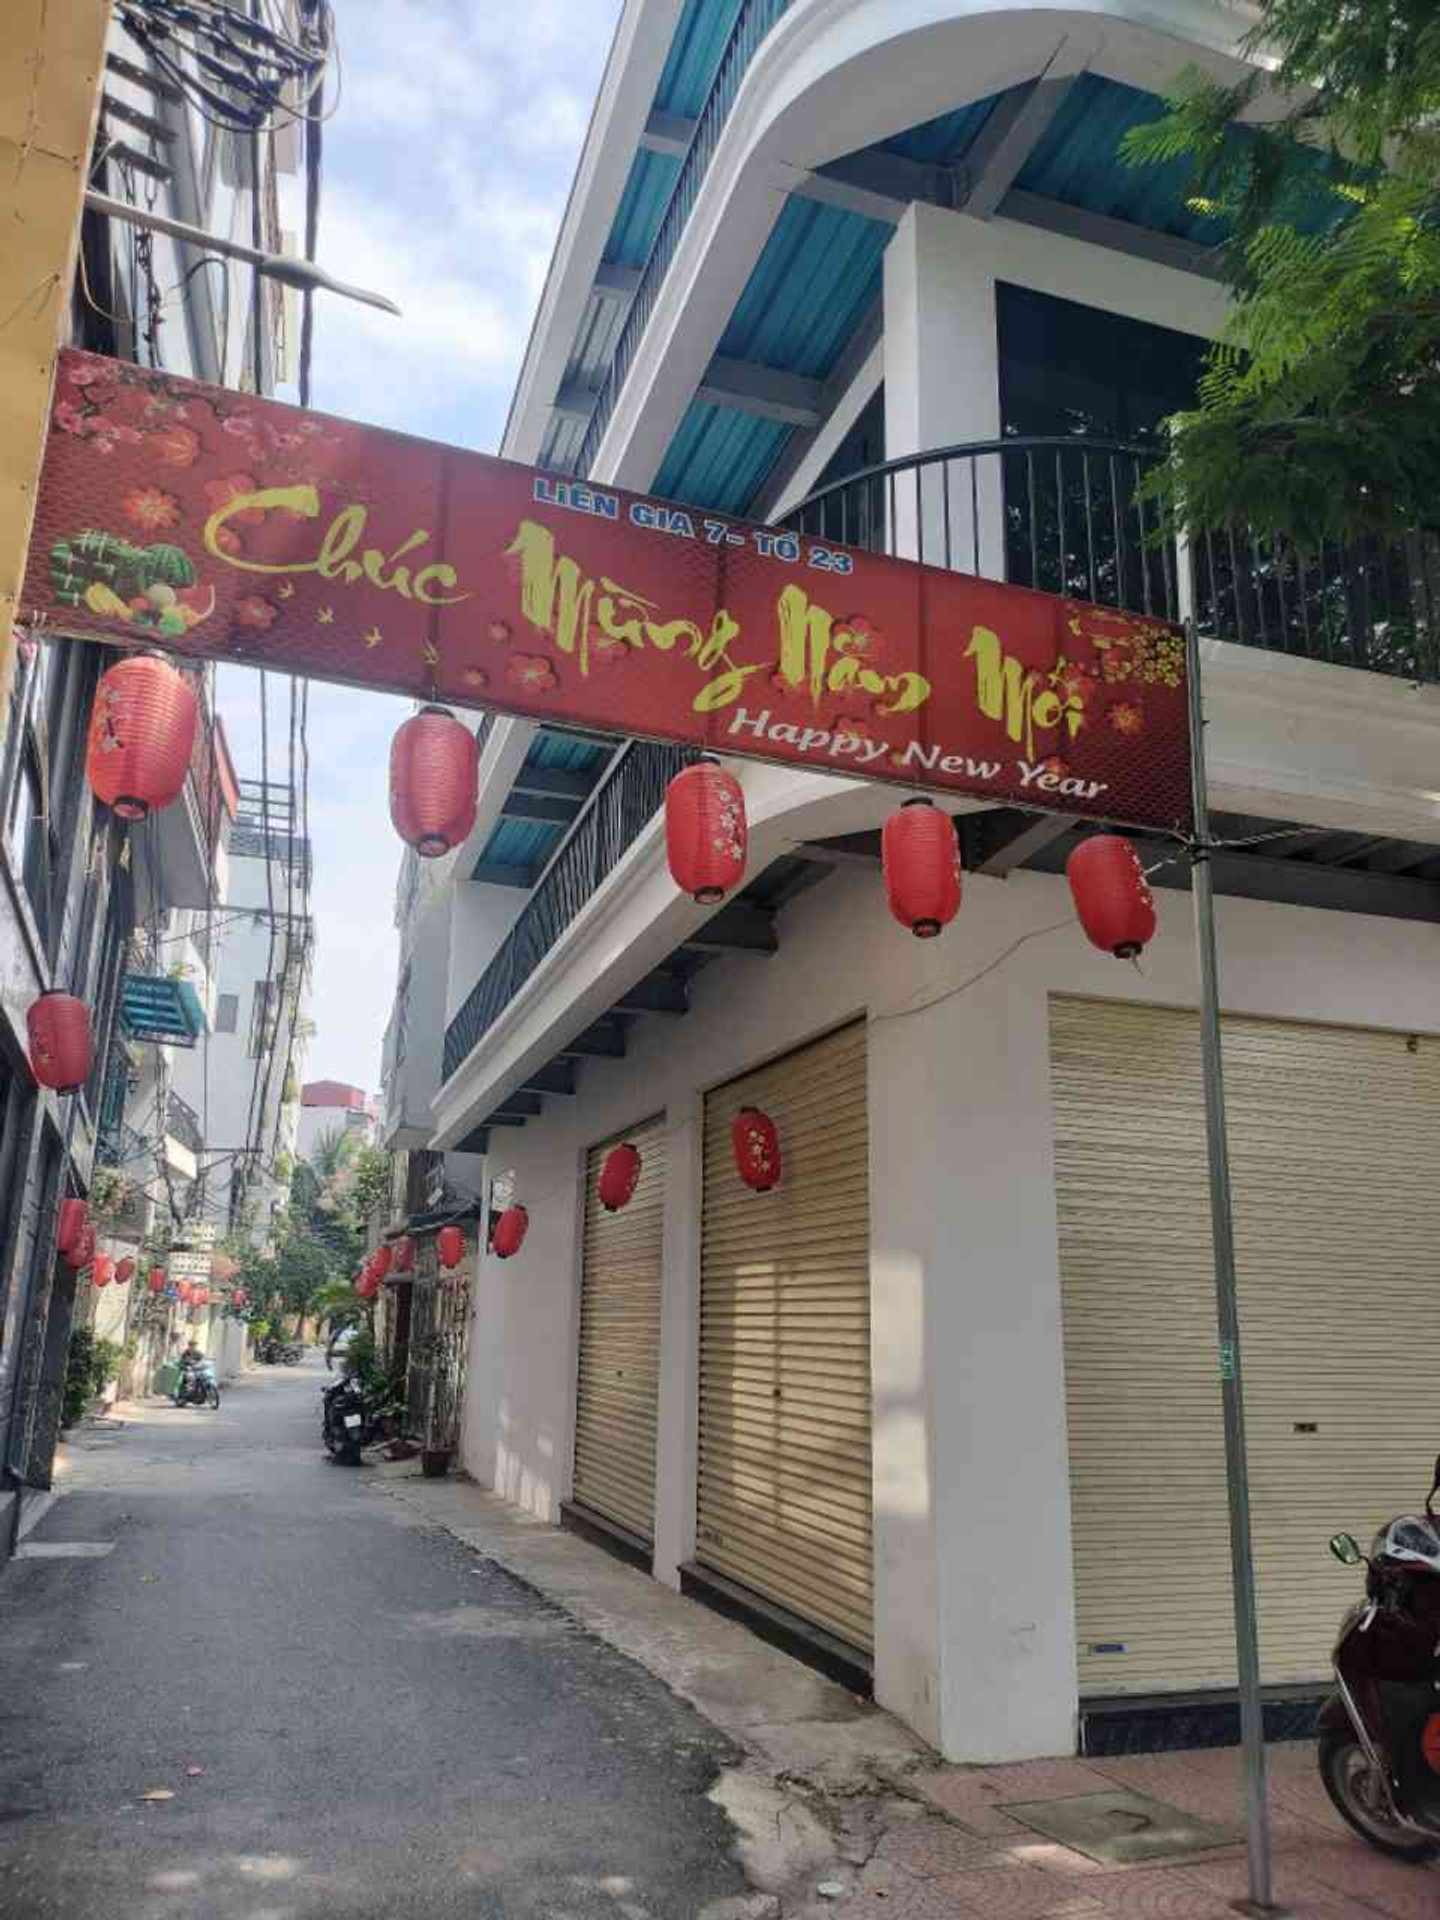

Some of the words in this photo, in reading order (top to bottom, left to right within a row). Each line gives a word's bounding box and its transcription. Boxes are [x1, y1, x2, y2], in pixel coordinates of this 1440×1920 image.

[629, 503, 697, 539] GIA
[756, 528, 802, 563] TỔ
[808, 545, 853, 576] 23
[203, 484, 471, 604] Chúc
[505, 519, 775, 712] Mừng
[777, 583, 932, 714] Năm
[963, 625, 1084, 763] Mới
[727, 706, 890, 763] Happy
[901, 740, 1001, 780] New
[1016, 760, 1109, 799] Year
